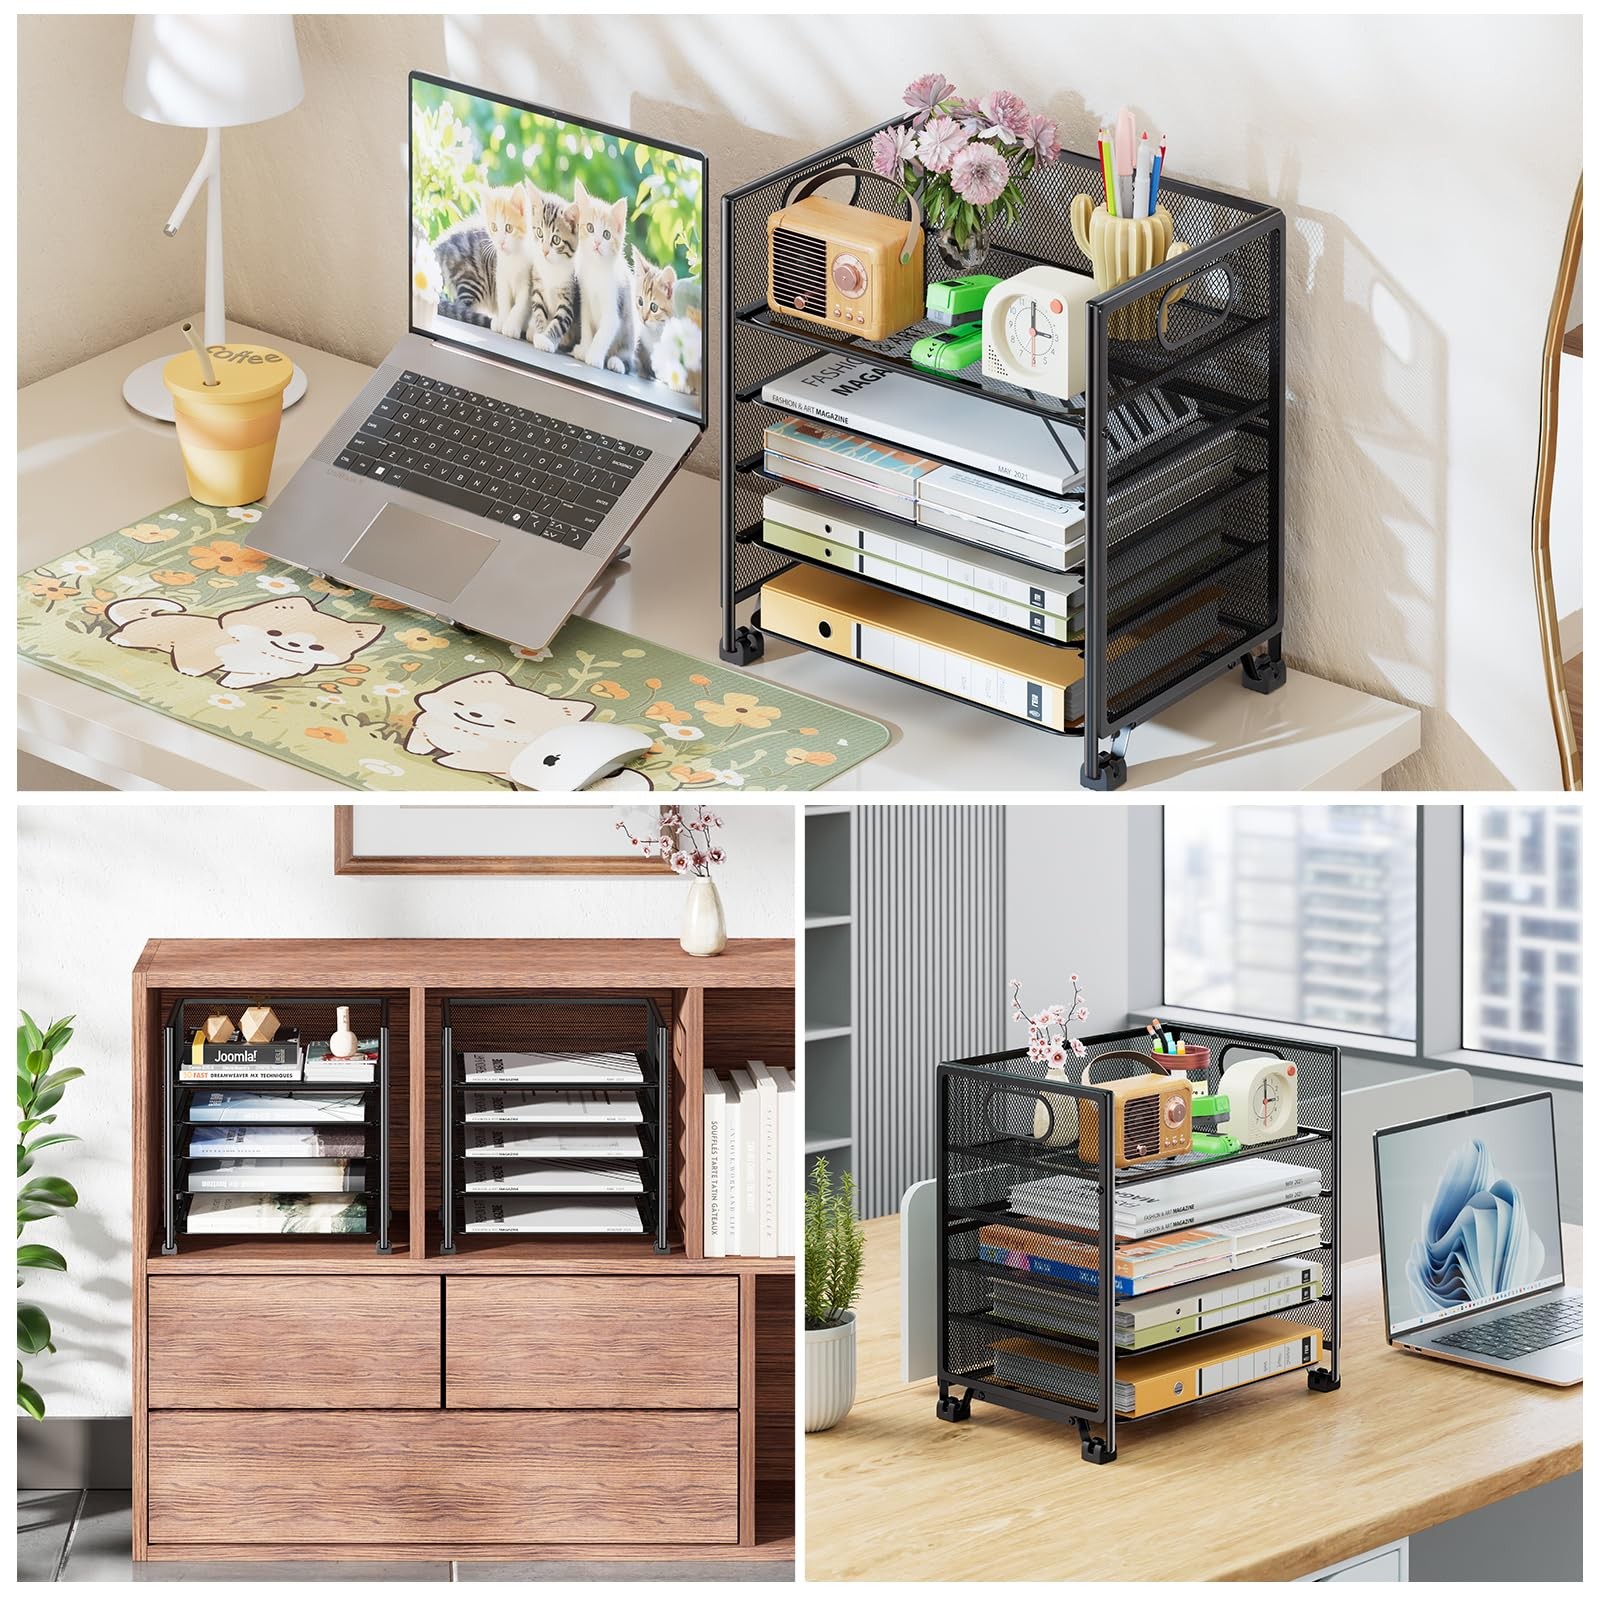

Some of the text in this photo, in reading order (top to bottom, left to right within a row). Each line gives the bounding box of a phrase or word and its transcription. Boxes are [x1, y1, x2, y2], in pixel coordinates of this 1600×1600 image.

[206, 346, 282, 364] Coffee
[830, 368, 892, 397] MAGA
[772, 394, 849, 425] FASHION & ART MAGAZINE
[998, 465, 1028, 480] MAY 2021
[214, 1050, 258, 1063] Joomla!
[1144, 1212, 1160, 1221] FASHION
[1173, 1204, 1194, 1214] MAGAZINE
[1144, 1225, 1160, 1234] FASHION
[1173, 1217, 1194, 1227] MAGAZINE
